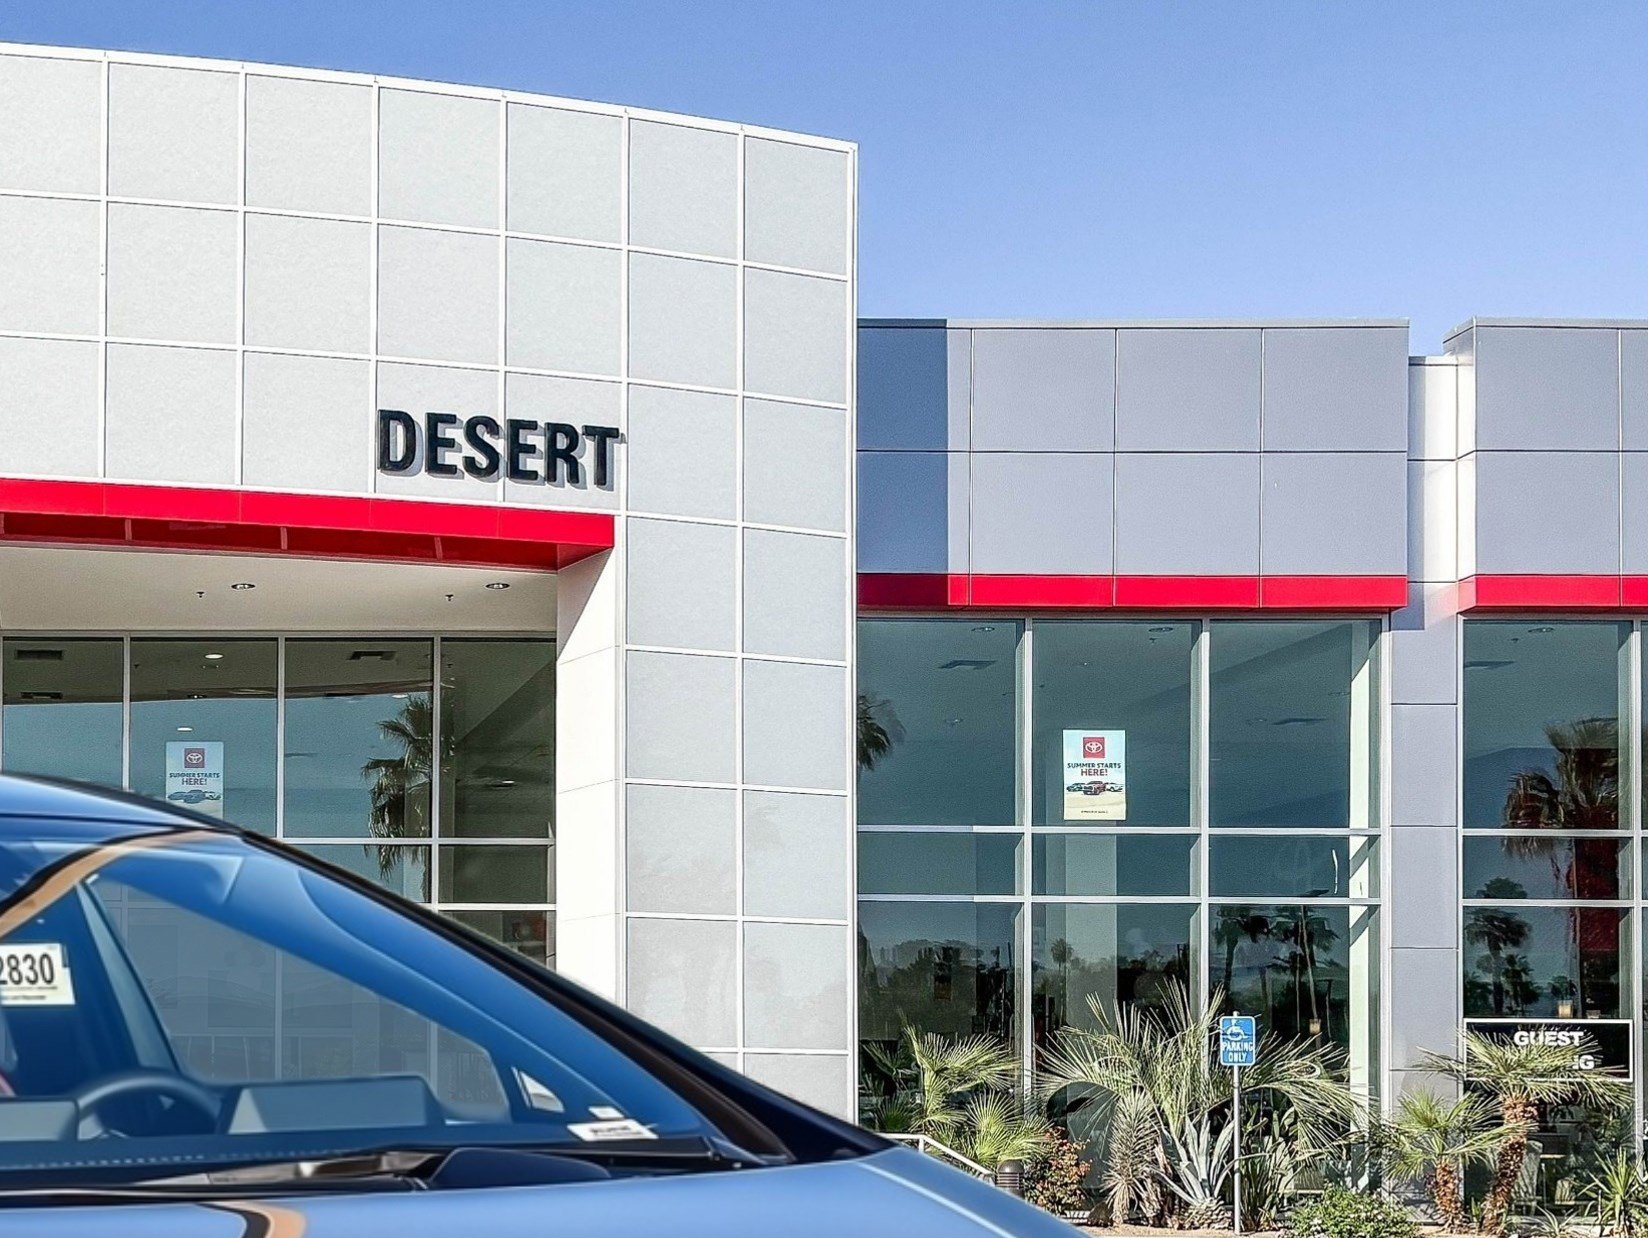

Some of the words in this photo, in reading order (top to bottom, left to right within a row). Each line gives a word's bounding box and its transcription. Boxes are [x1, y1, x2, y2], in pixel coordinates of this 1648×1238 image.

[377, 409, 620, 486] DESERT
[1080, 768, 1108, 777] HERE!
[181, 778, 208, 786] HERE!
[1513, 1031, 1584, 1047] GUEST
[1222, 1041, 1253, 1051] PARKING
[1228, 1052, 1247, 1062] ONLY
